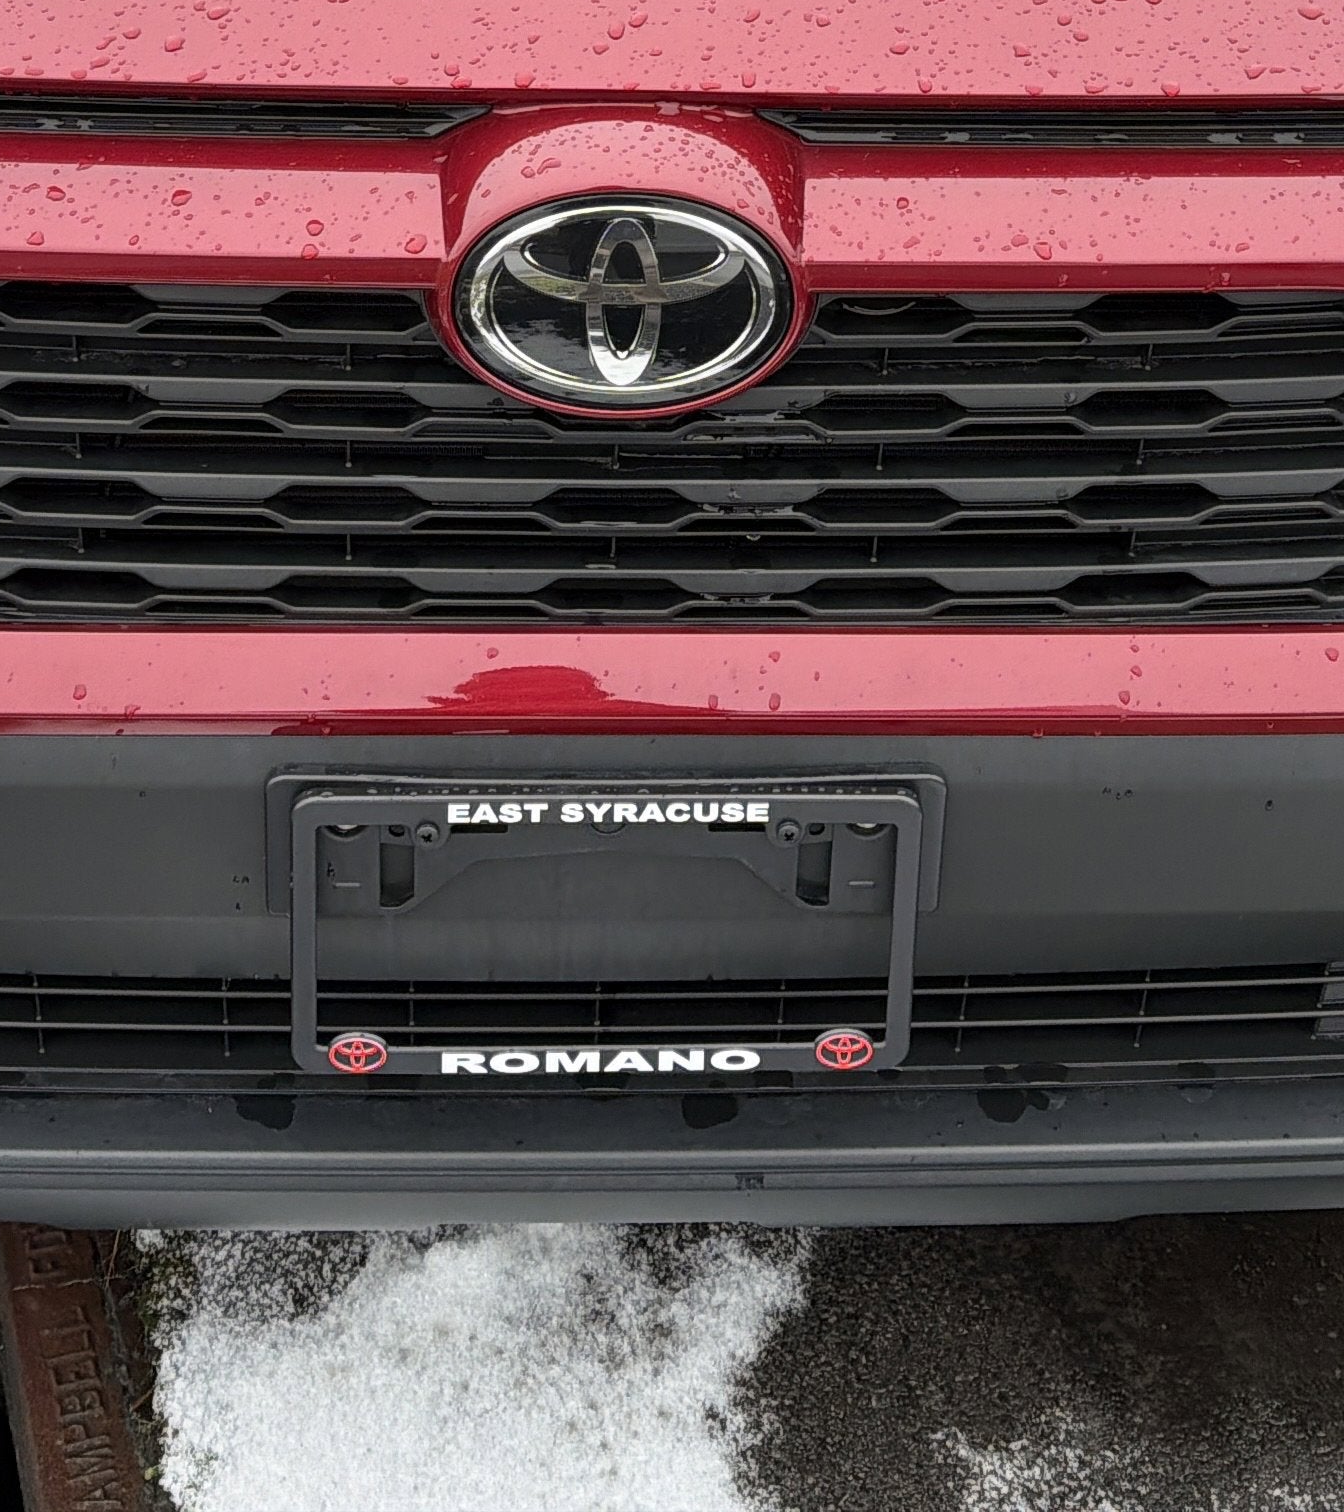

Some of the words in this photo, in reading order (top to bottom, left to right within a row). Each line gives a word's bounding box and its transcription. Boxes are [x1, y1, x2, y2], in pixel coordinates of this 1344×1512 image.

[447, 802, 549, 824] EAST
[560, 802, 770, 824] SYRACUSE
[441, 1048, 761, 1074] ROMANO
[38, 1305, 123, 1512] AMPBELL
